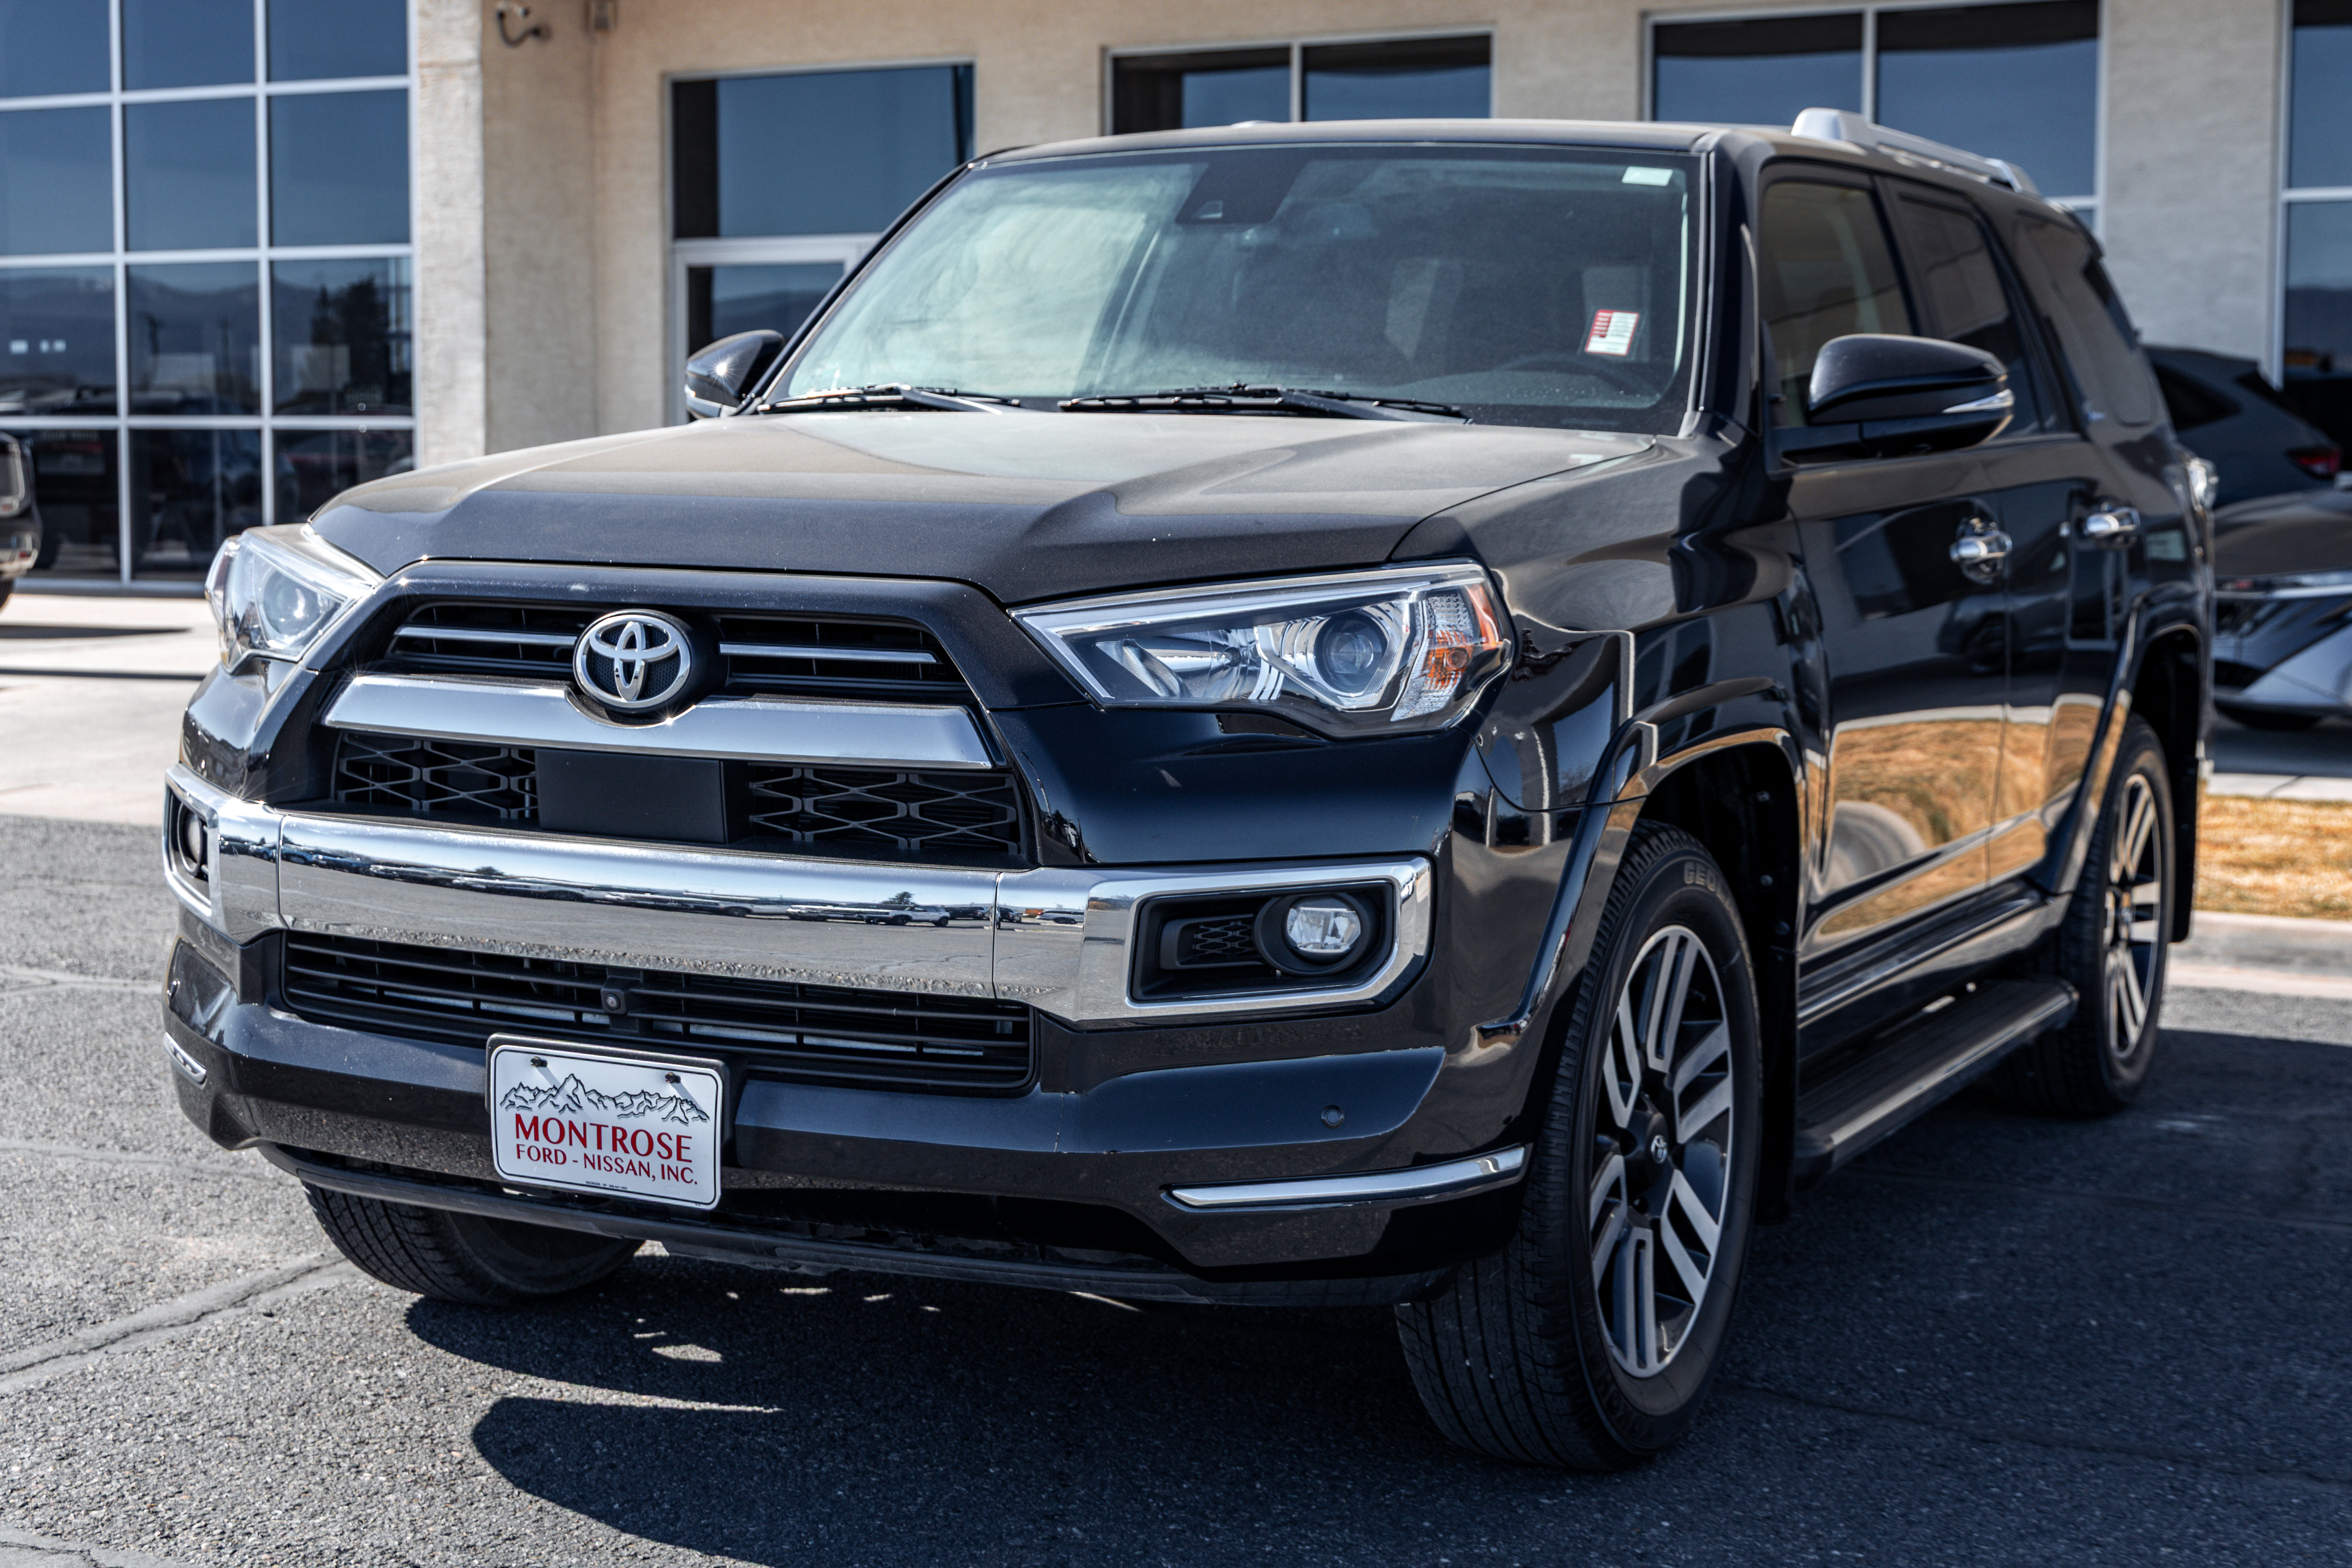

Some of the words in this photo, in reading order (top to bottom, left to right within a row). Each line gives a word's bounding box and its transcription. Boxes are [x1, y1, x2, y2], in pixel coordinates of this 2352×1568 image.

[515, 1113, 692, 1163] MONTROSE
[516, 1144, 567, 1165] FORD
[584, 1154, 656, 1182] NISSAN,
[661, 1164, 698, 1185] INC.
